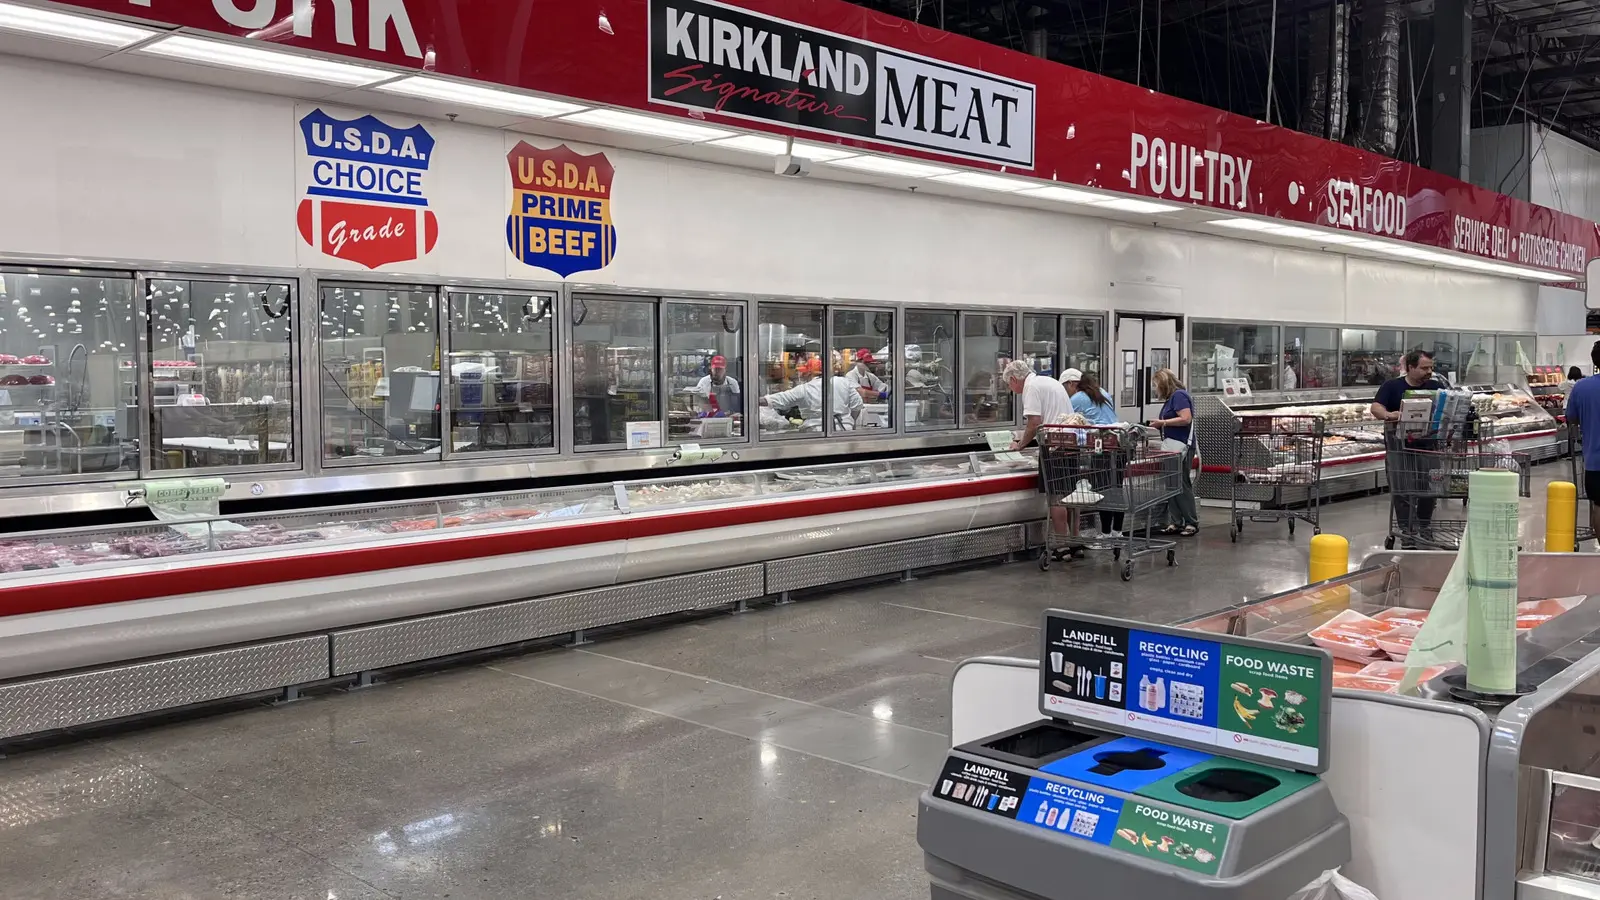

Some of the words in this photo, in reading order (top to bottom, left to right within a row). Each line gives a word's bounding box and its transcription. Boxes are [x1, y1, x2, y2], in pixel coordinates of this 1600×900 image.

[666, 7, 869, 96] KIRKLAND
[664, 64, 867, 122] Signature
[881, 66, 1018, 148] MEAT
[312, 122, 426, 160] U.S.D.A.
[313, 160, 422, 196] CHOICE
[518, 156, 605, 193] U.S.D.A.
[1130, 133, 1252, 208] POULTRY
[522, 193, 602, 221] PRIME
[1327, 178, 1406, 236] SEAFOOD
[328, 217, 406, 255] Grade
[529, 226, 596, 257] BEEF
[1454, 214, 1490, 255] SERVICE
[1491, 225, 1509, 258] DELI
[1519, 232, 1559, 268] ROTISSERIE
[1560, 242, 1586, 273] CHICKEN
[1063, 629, 1117, 646] LANDFILL
[1139, 641, 1208, 661] RECYCLING
[1226, 655, 1263, 670] FOOD
[1267, 661, 1314, 678] WASTE
[964, 763, 1009, 781] LANDFILL
[1046, 782, 1105, 804] RECYCLING
[1135, 804, 1169, 821] FOOD
[1172, 814, 1214, 834] WASTE
